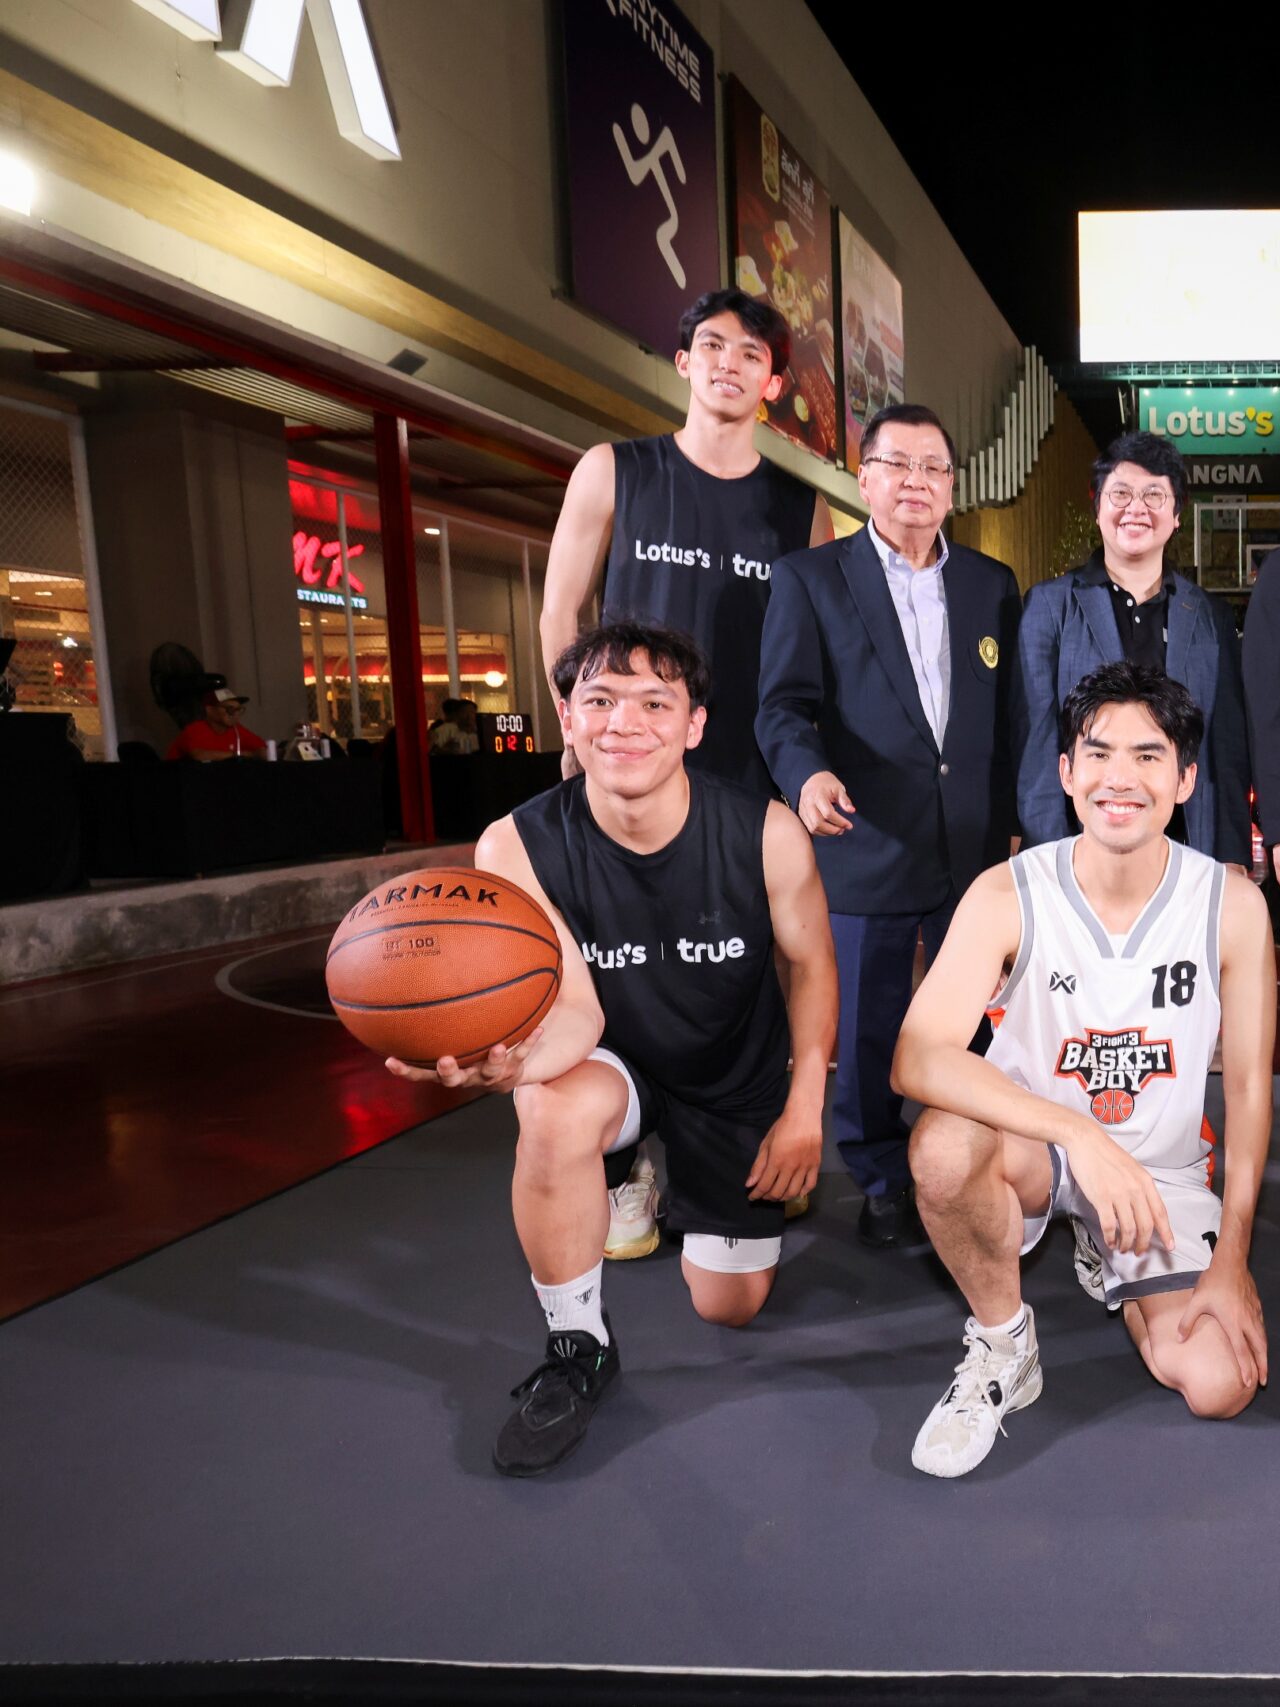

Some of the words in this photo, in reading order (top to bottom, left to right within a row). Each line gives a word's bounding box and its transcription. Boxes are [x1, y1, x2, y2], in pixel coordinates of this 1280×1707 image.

[619, 0, 701, 104] FITNESS
[1149, 406, 1274, 436] Lotus's
[635, 539, 711, 569] Lotus's
[732, 553, 772, 581] tru
[296, 588, 367, 609] STAURATS
[496, 714, 523, 732] 10:00
[495, 736, 503, 753] 0
[526, 736, 533, 753] 0
[409, 937, 434, 949] 100
[676, 936, 745, 963] true
[1152, 960, 1197, 1009] 18
[1061, 1042, 1168, 1070] BASKET
[1086, 1068, 1141, 1092] BOY
